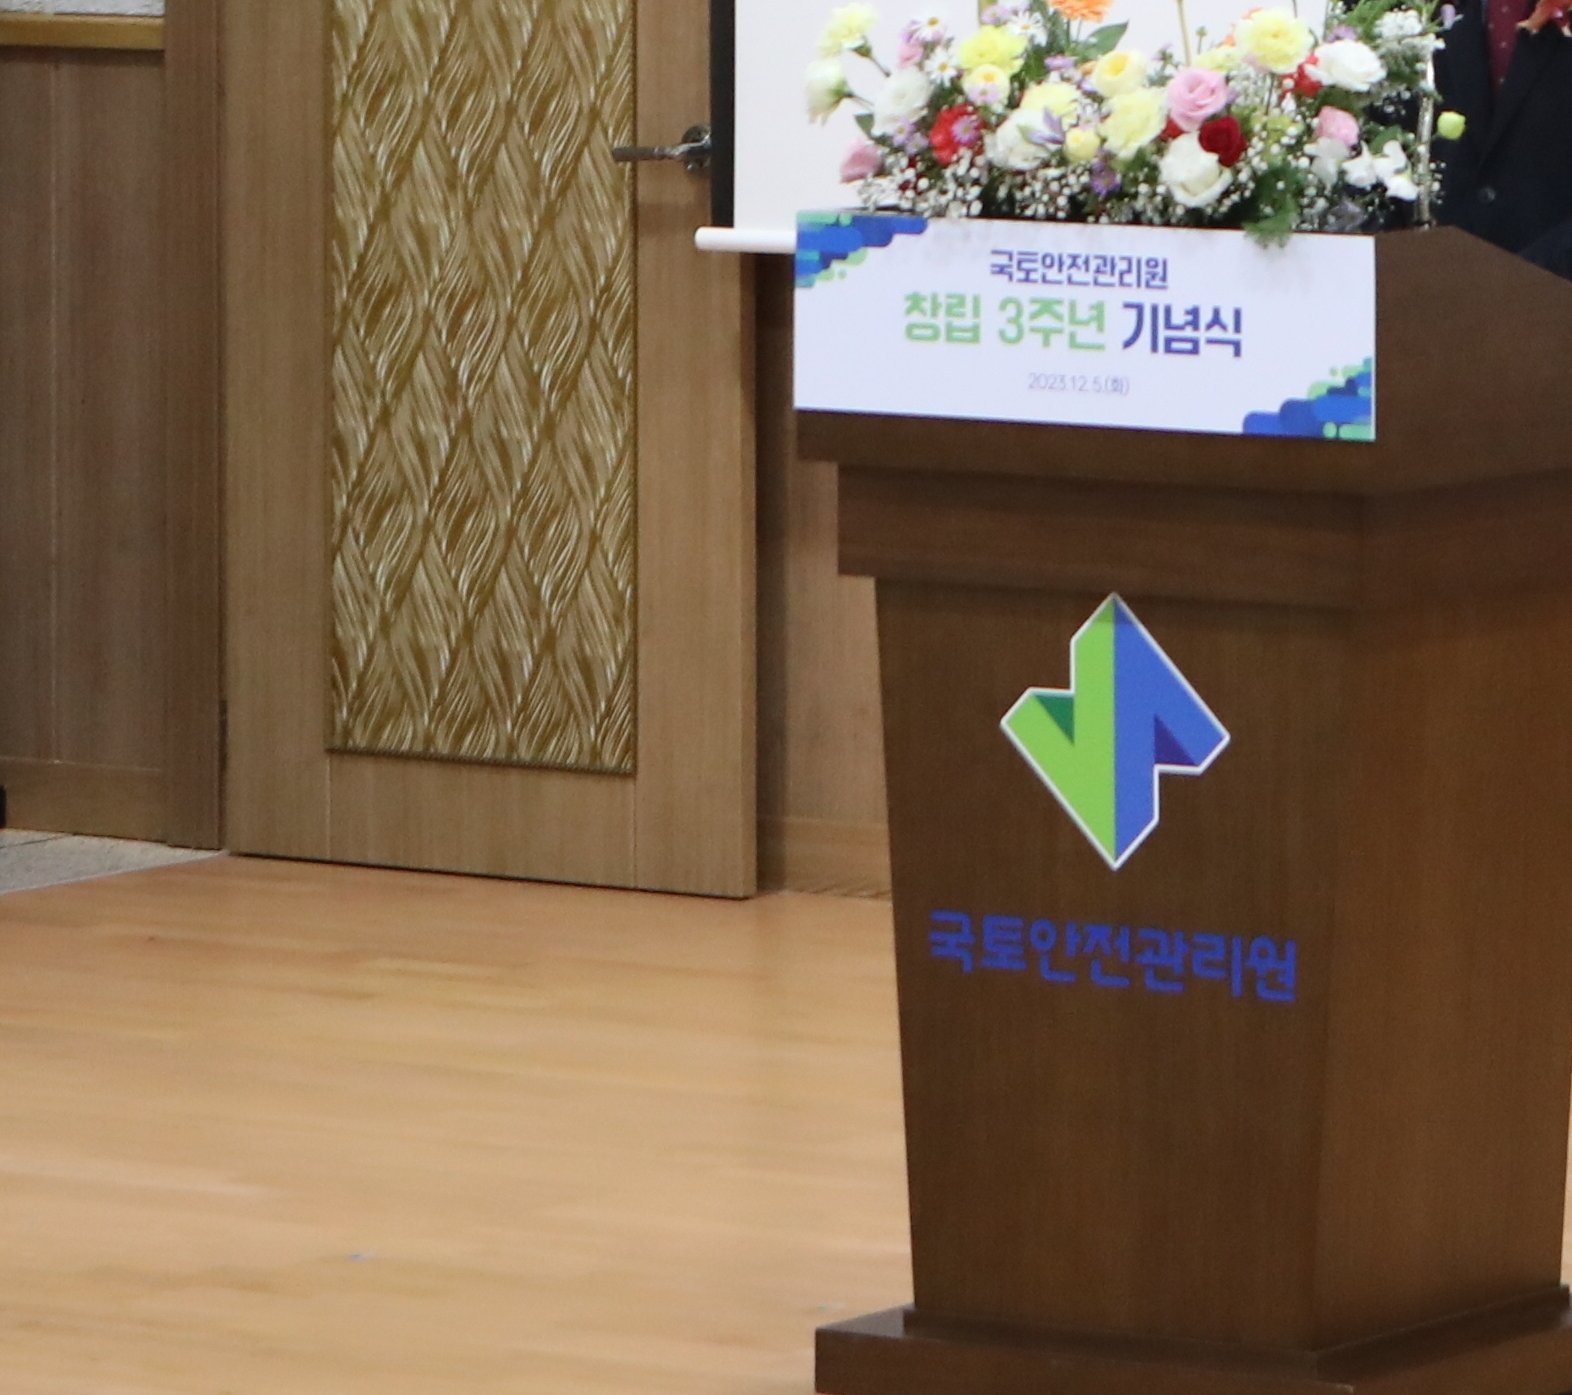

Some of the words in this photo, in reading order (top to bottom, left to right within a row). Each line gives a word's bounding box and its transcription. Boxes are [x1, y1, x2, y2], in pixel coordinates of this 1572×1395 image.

[990, 249, 1169, 290] 국토안전관리원
[904, 291, 981, 345] 창립
[998, 297, 1106, 351] 3주년
[1121, 301, 1243, 357] 기념식
[929, 909, 1297, 1002] 국토안전관리원
